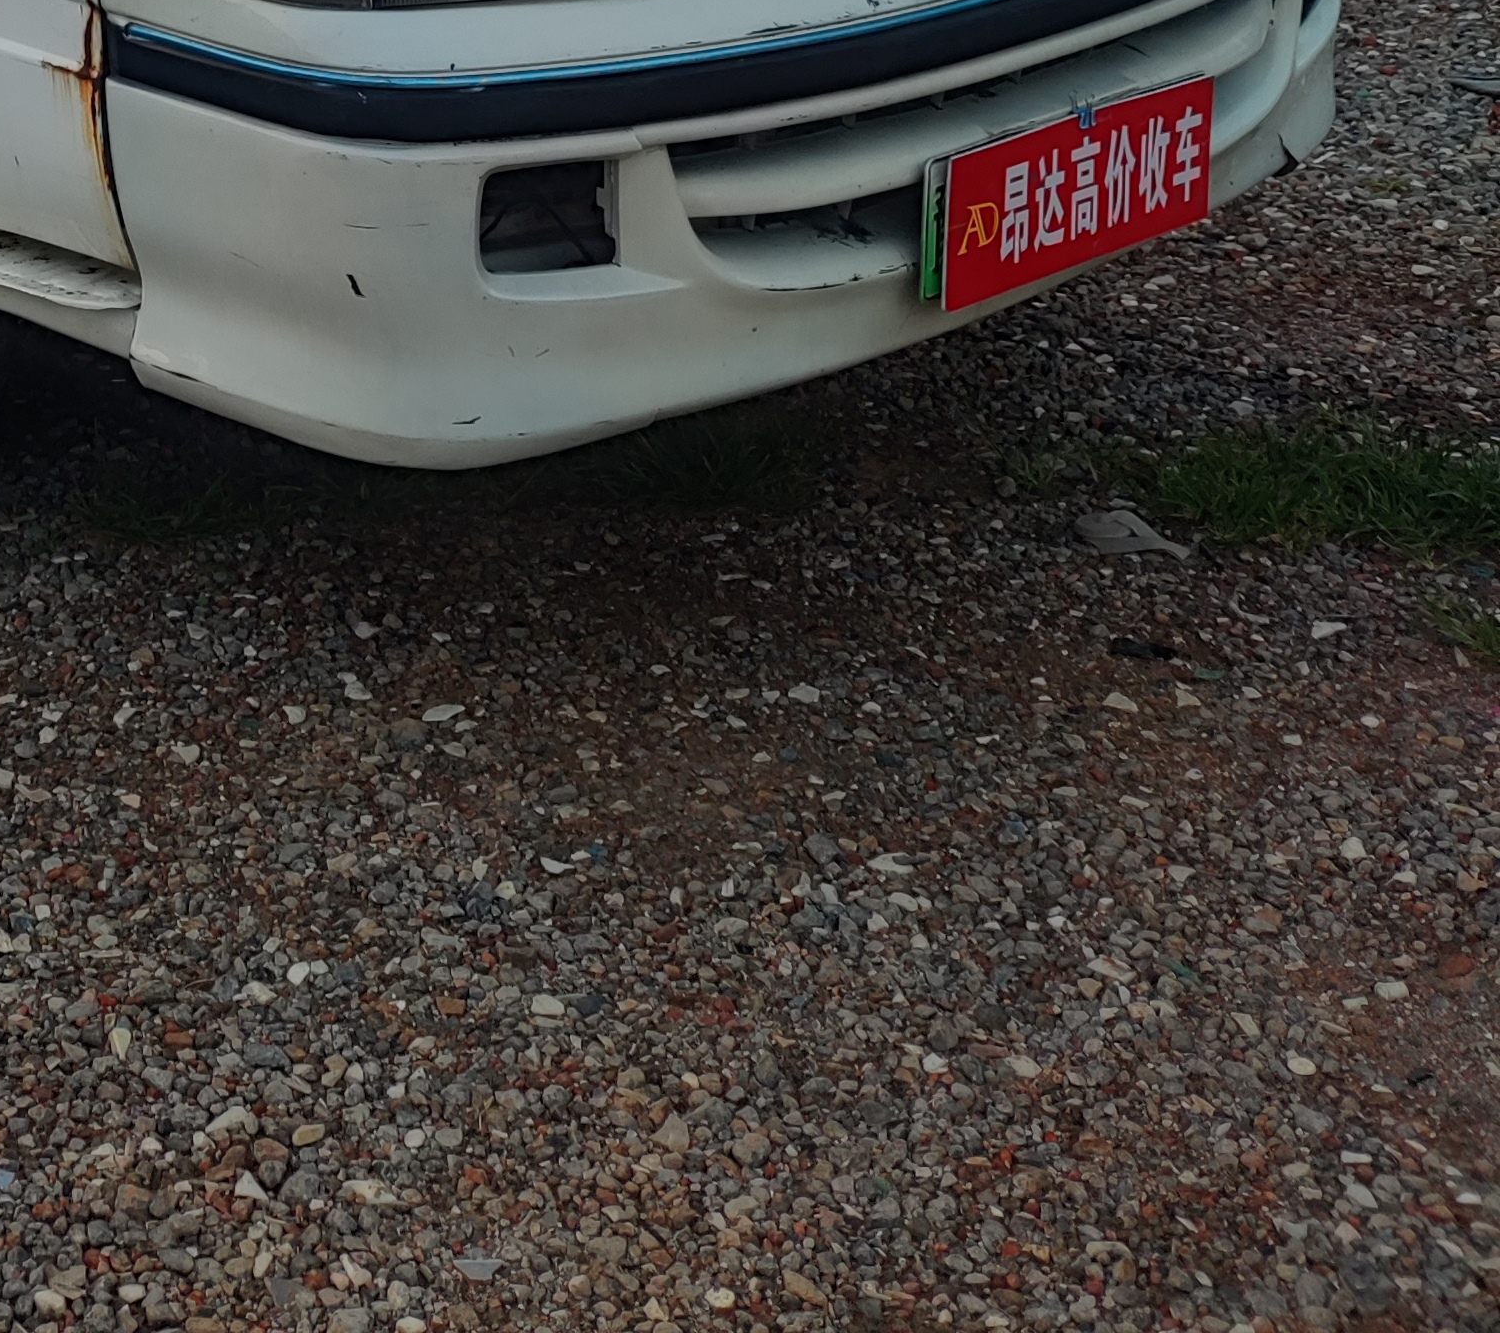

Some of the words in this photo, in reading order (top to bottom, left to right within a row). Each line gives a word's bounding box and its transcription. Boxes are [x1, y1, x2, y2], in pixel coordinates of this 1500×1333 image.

[1000, 106, 1203, 264] 昂达高价收车
